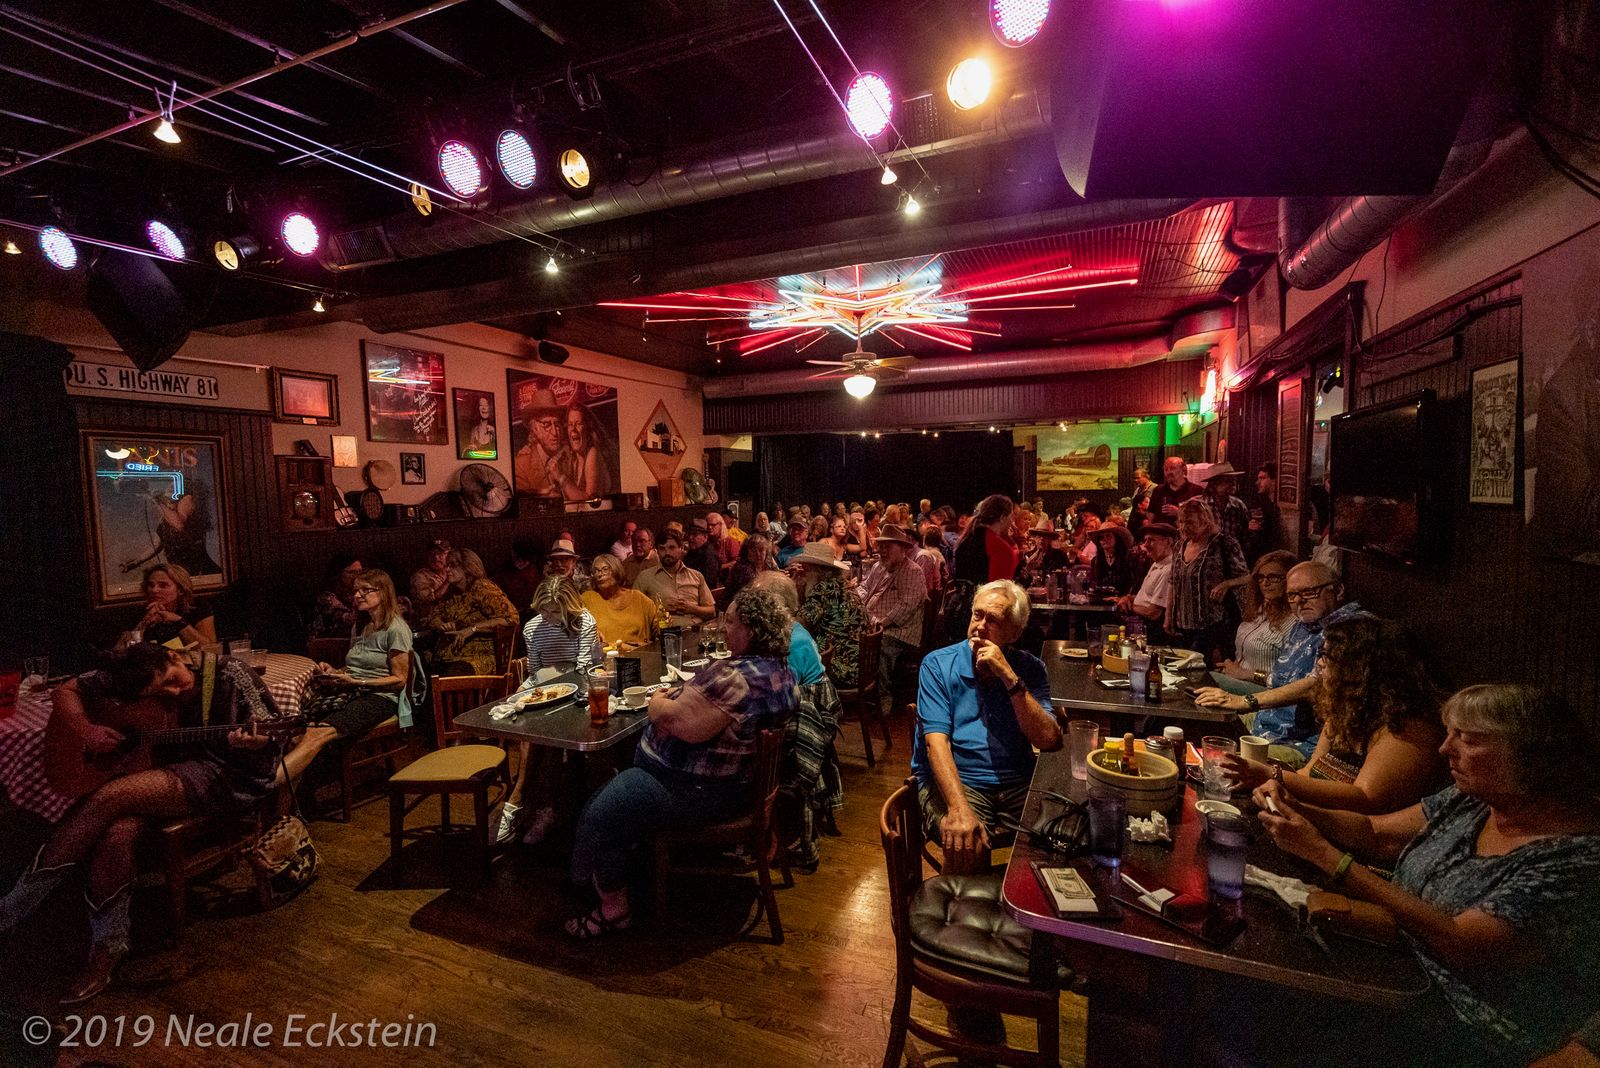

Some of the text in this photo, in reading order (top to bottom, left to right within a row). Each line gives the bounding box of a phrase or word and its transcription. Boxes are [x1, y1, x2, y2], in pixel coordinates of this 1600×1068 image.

[73, 364, 213, 396] U. S. HIGHWAY 81
